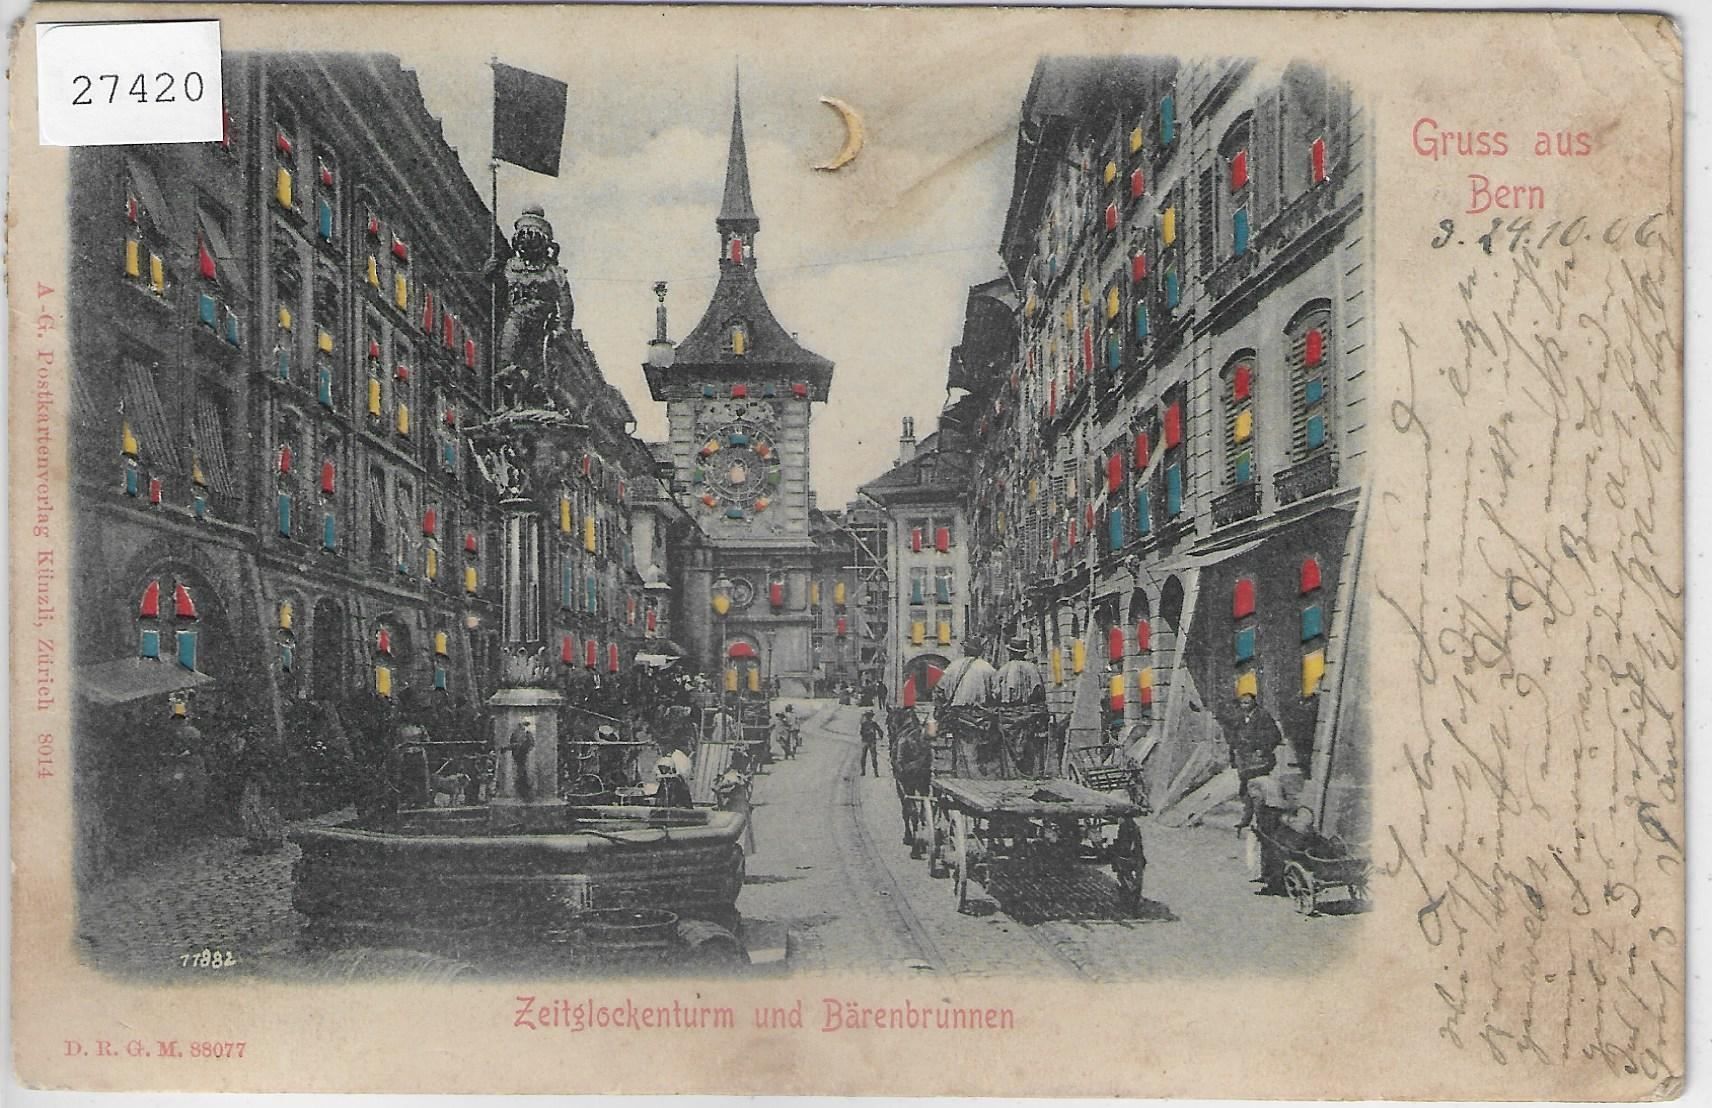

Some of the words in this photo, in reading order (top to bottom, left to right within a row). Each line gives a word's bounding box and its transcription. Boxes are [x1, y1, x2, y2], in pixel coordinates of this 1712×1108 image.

[72, 72, 204, 105] 27420
[1412, 117, 1508, 160] Gruss
[1534, 130, 1592, 156] aus
[1465, 173, 1544, 214] Bern
[33, 349, 56, 538] Postkartenverlag
[36, 639, 56, 712] Zürich
[37, 733, 54, 780] 8014
[513, 995, 734, 1033] Zeitglockenturm
[755, 1000, 803, 1029] und
[821, 997, 1015, 1034] Bärenbrunnen
[64, 1040, 88, 1057] D.
[156, 1040, 183, 1057] M.
[190, 1041, 247, 1059] 88077
